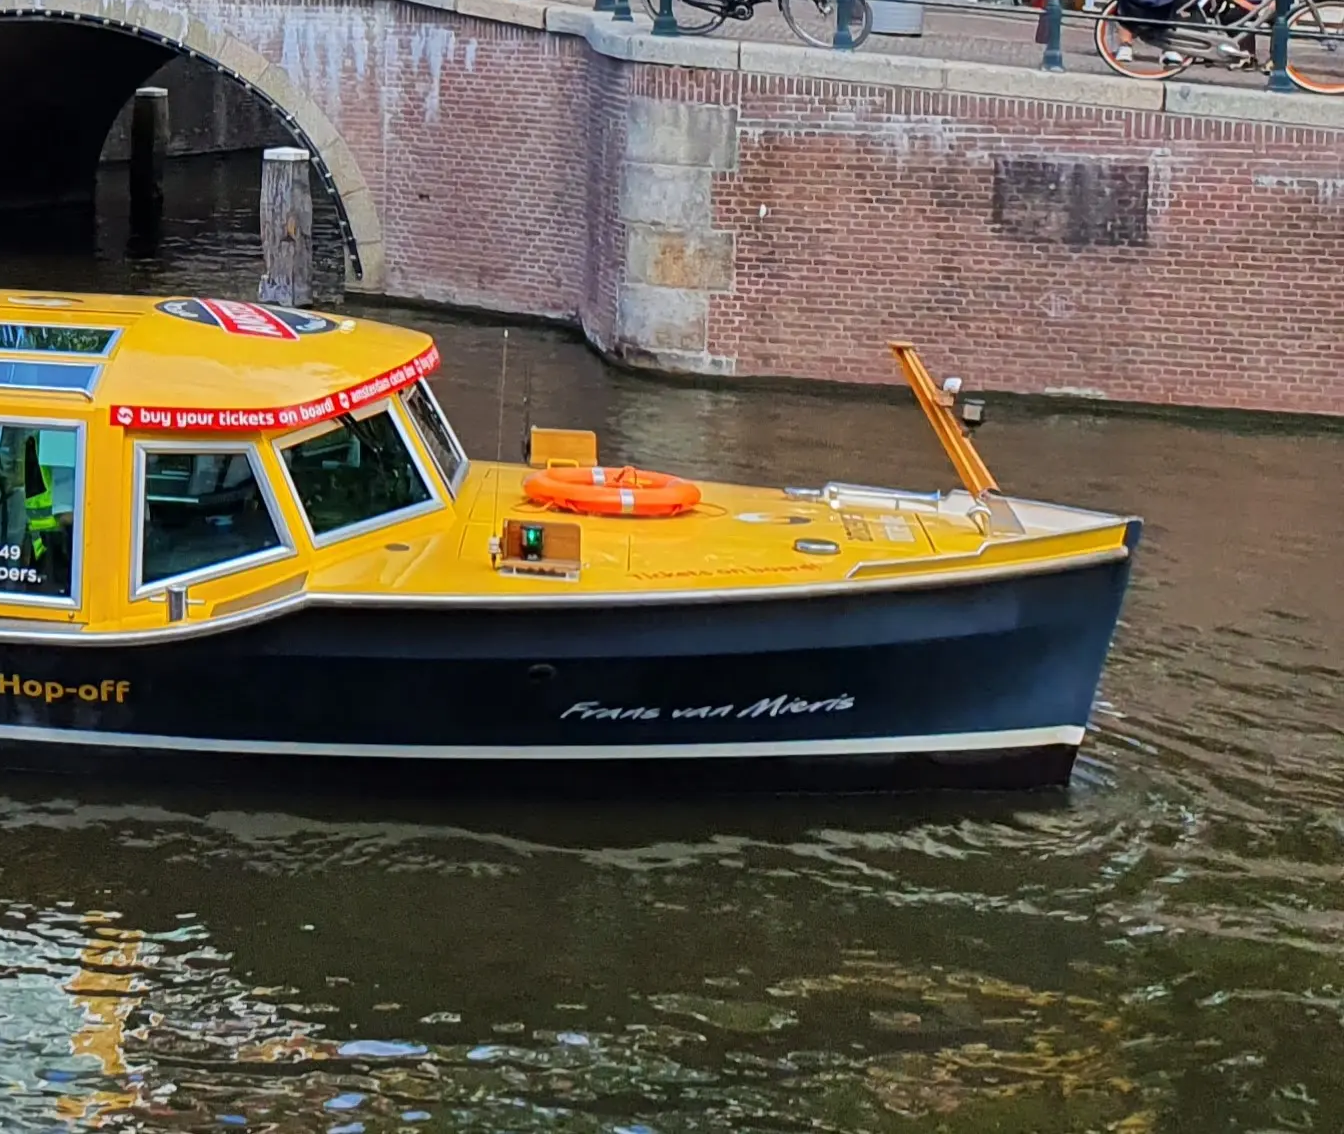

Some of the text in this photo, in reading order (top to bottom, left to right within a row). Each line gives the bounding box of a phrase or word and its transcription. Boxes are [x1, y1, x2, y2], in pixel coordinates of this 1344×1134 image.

[140, 408, 171, 427] buy
[176, 412, 214, 428] your
[219, 409, 275, 427] tickets
[278, 410, 298, 424] on
[301, 397, 335, 421] board!
[560, 693, 855, 719] Frans van Mieris
